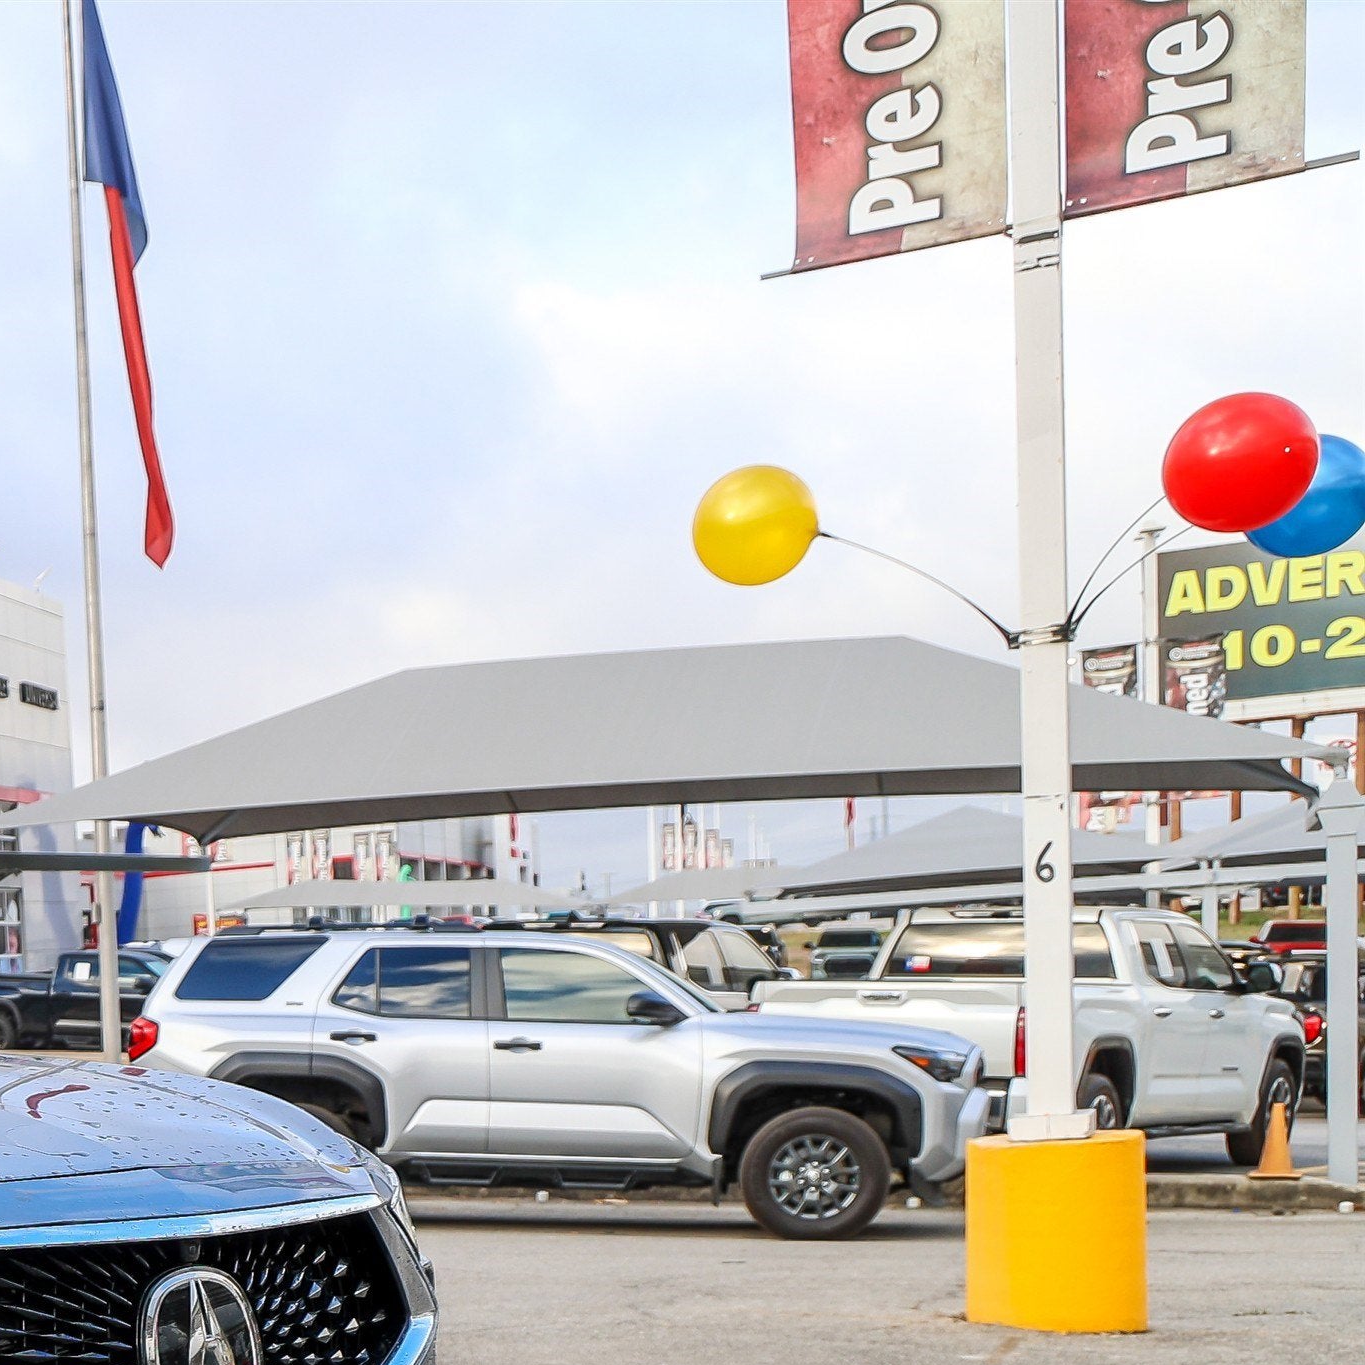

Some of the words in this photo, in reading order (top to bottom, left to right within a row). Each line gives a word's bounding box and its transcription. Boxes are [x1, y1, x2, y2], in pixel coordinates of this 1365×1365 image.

[843, 0, 941, 75] O
[1124, 10, 1233, 174] Pre
[849, 82, 942, 235] Pre
[1165, 550, 1365, 617] ADVER
[1036, 841, 1054, 882] 6
